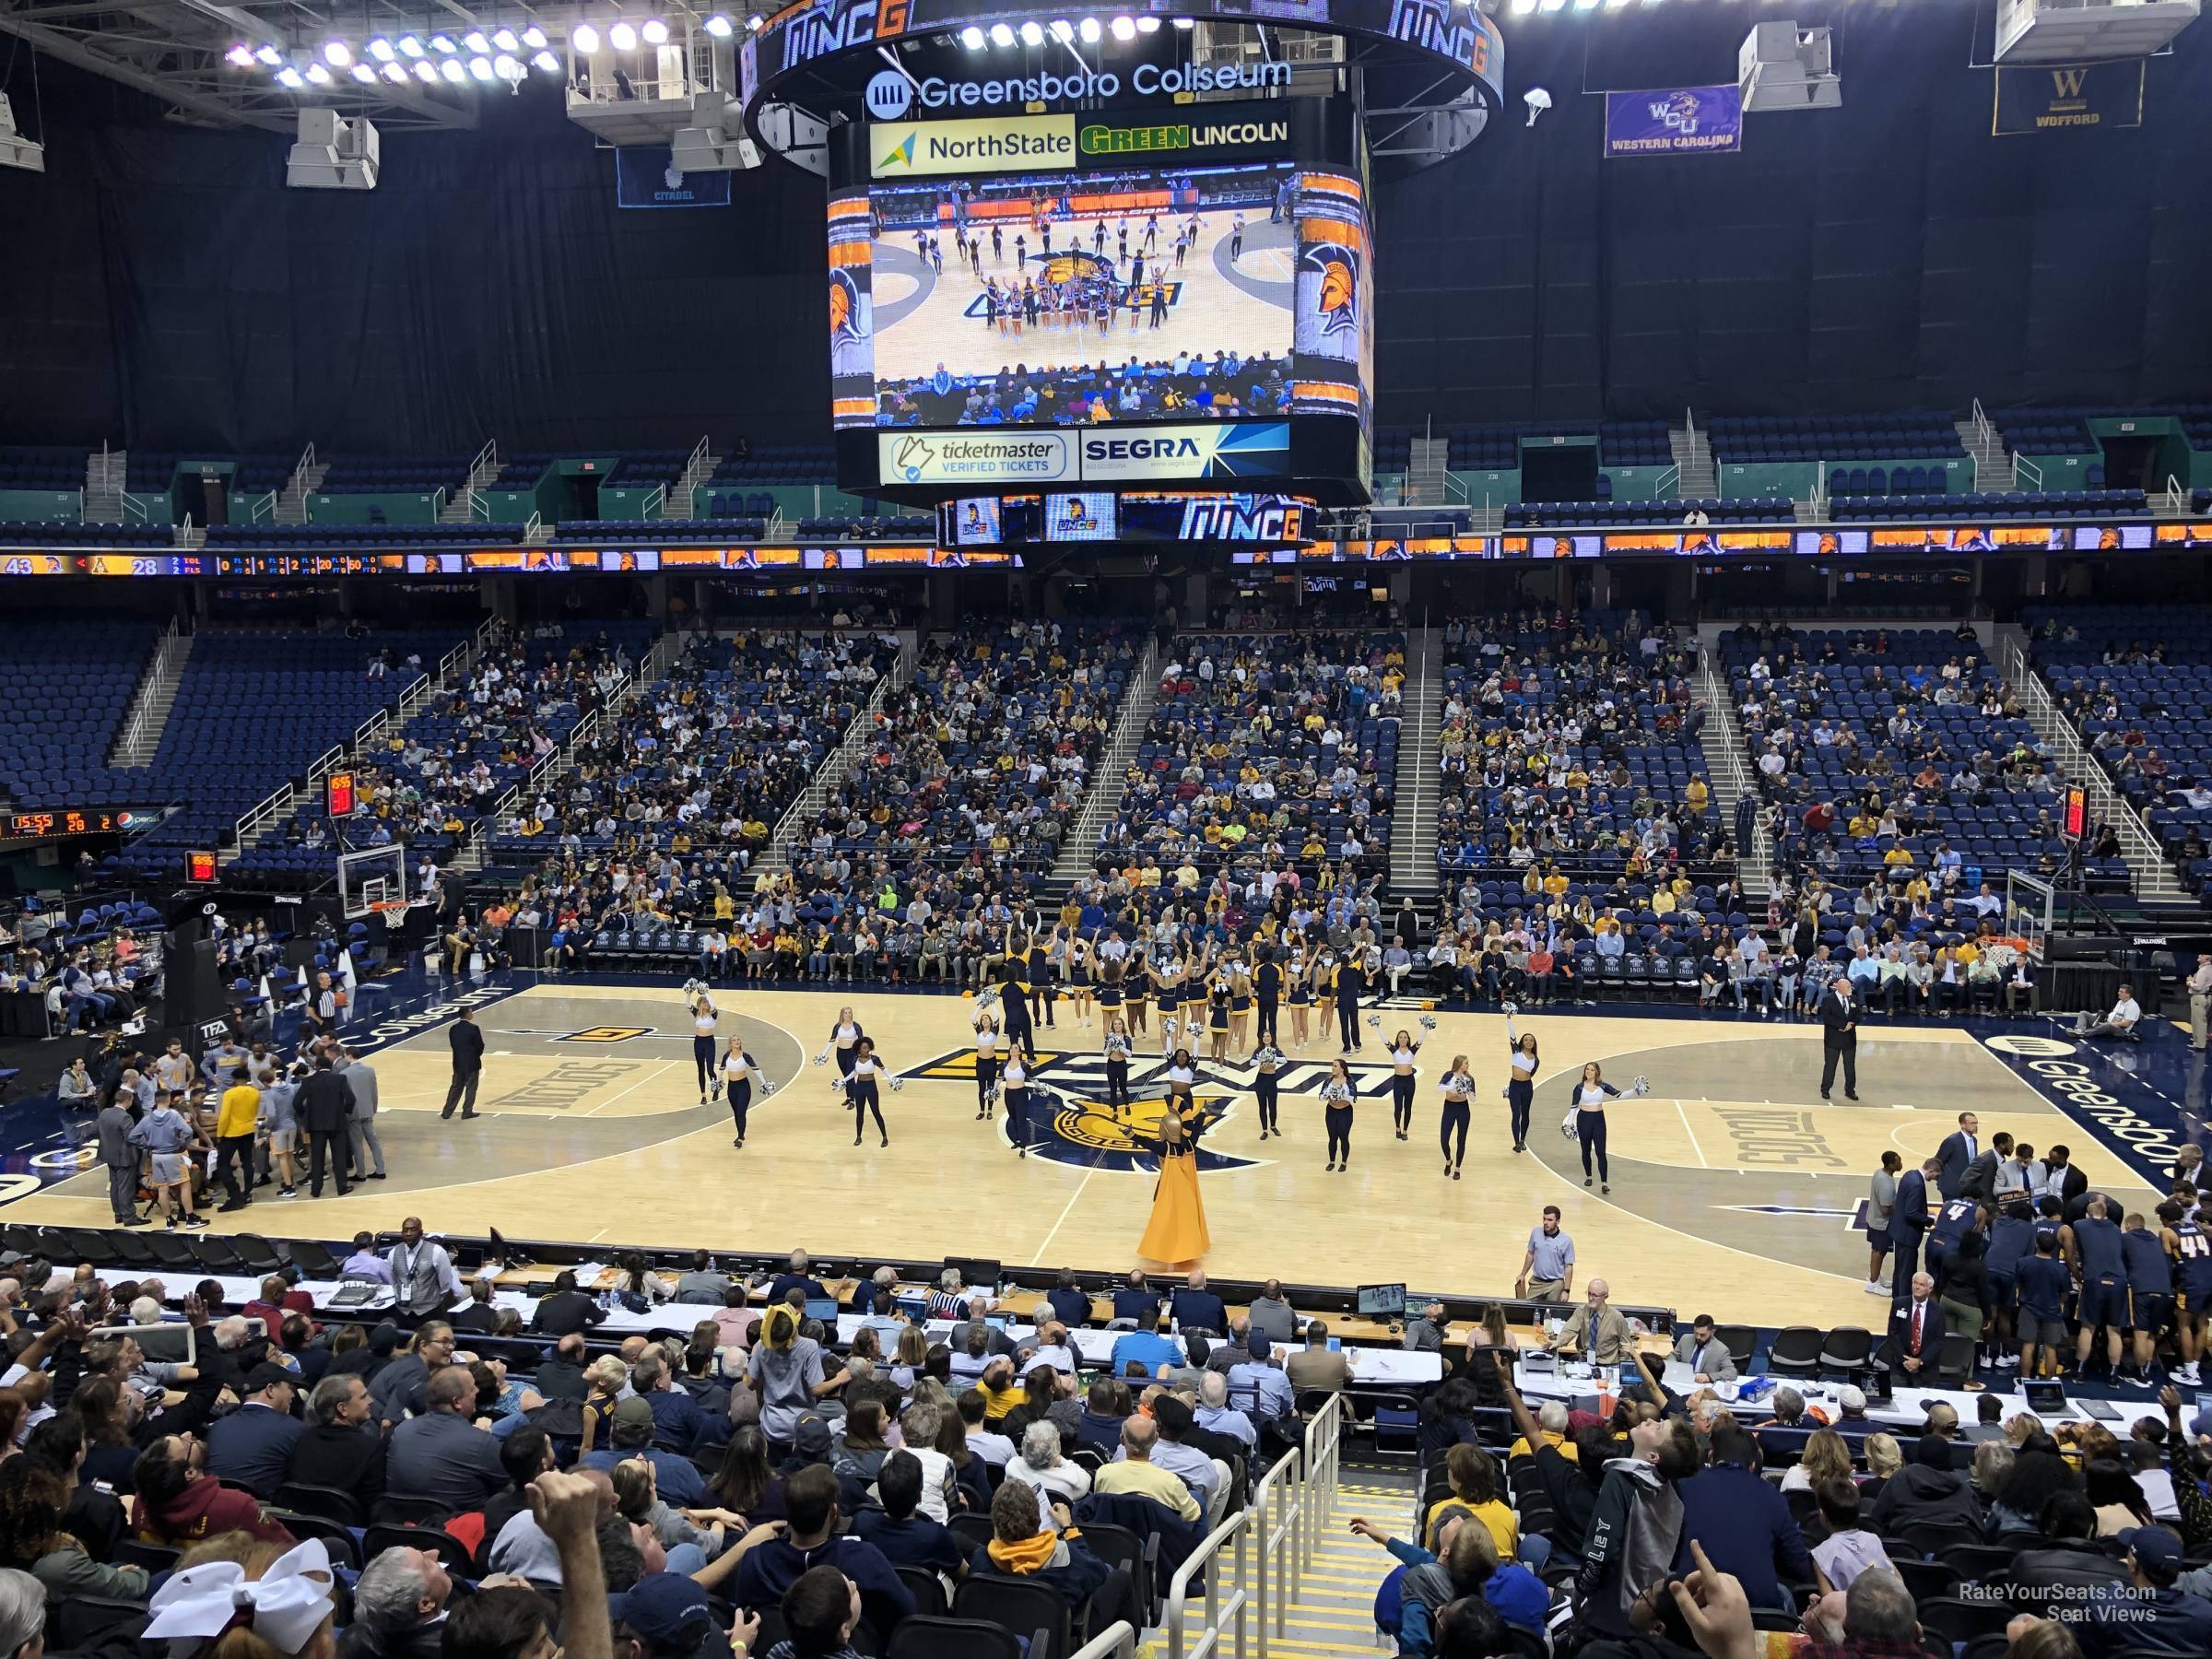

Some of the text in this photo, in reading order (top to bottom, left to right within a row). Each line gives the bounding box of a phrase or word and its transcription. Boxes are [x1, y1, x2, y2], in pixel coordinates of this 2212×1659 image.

[920, 59, 1291, 108] Greensboro Coliseum
[2052, 69, 2088, 98] W
[1649, 102, 1699, 134] WCU
[2036, 112, 2100, 127] WOFFORD
[930, 132, 1071, 159] NorthState
[1080, 122, 1288, 154] GREEN LINCOLN
[1612, 134, 1734, 150] WESTERN CAROLINA
[654, 191, 694, 201] CITADEL
[942, 441, 1053, 460] ticketmaster
[1086, 438, 1200, 460] SEGRA
[941, 461, 1049, 473] VERIFIED TICKETS
[1150, 460, 1202, 468] www.segra.com
[1057, 518, 1097, 531] UNCG
[1178, 497, 1301, 541] UNCG
[962, 524, 987, 535] UNCG
[6, 558, 33, 574] 43
[133, 559, 158, 575] 28
[258, 560, 265, 570] 1
[291, 560, 299, 570] 2
[320, 559, 332, 570] 20
[17, 815, 53, 828] 15:55
[68, 820, 84, 831] 28
[101, 818, 110, 829] 2
[38, 826, 44, 835] 2
[275, 896, 302, 904] SPALDING
[2133, 936, 2167, 945] SPALDING
[337, 987, 512, 1049] Coliseum
[200, 1020, 229, 1039] TFA
[1947, 1203, 1969, 1222] 4
[2180, 1235, 2210, 1259] 44
